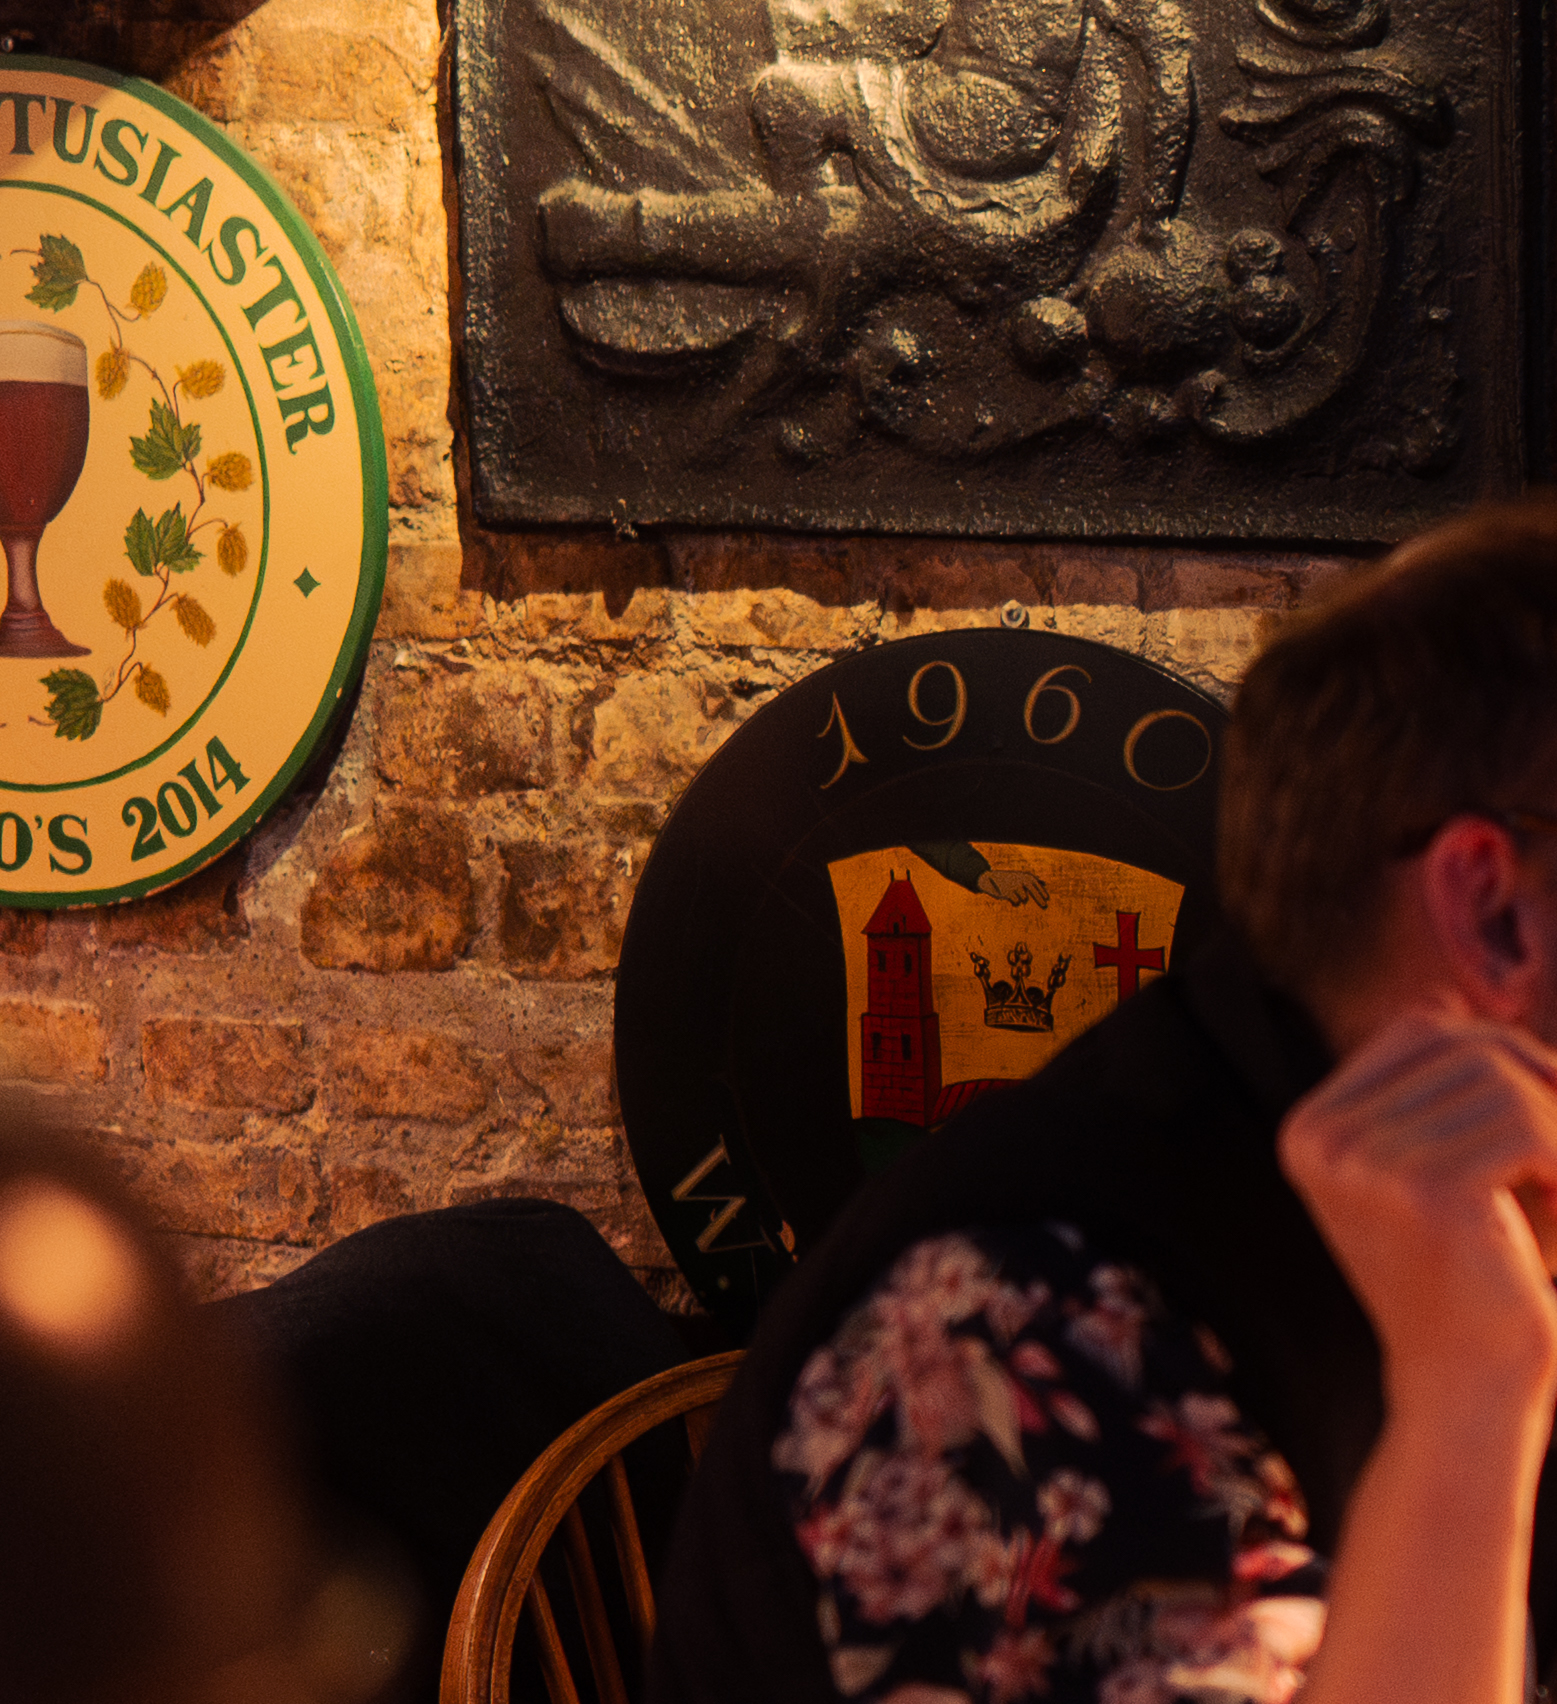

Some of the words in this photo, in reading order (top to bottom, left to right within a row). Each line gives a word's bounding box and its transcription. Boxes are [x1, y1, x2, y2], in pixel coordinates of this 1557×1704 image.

[0, 91, 337, 455] TUSIASTER
[816, 660, 1212, 790] 1960
[121, 735, 252, 864] 2014
